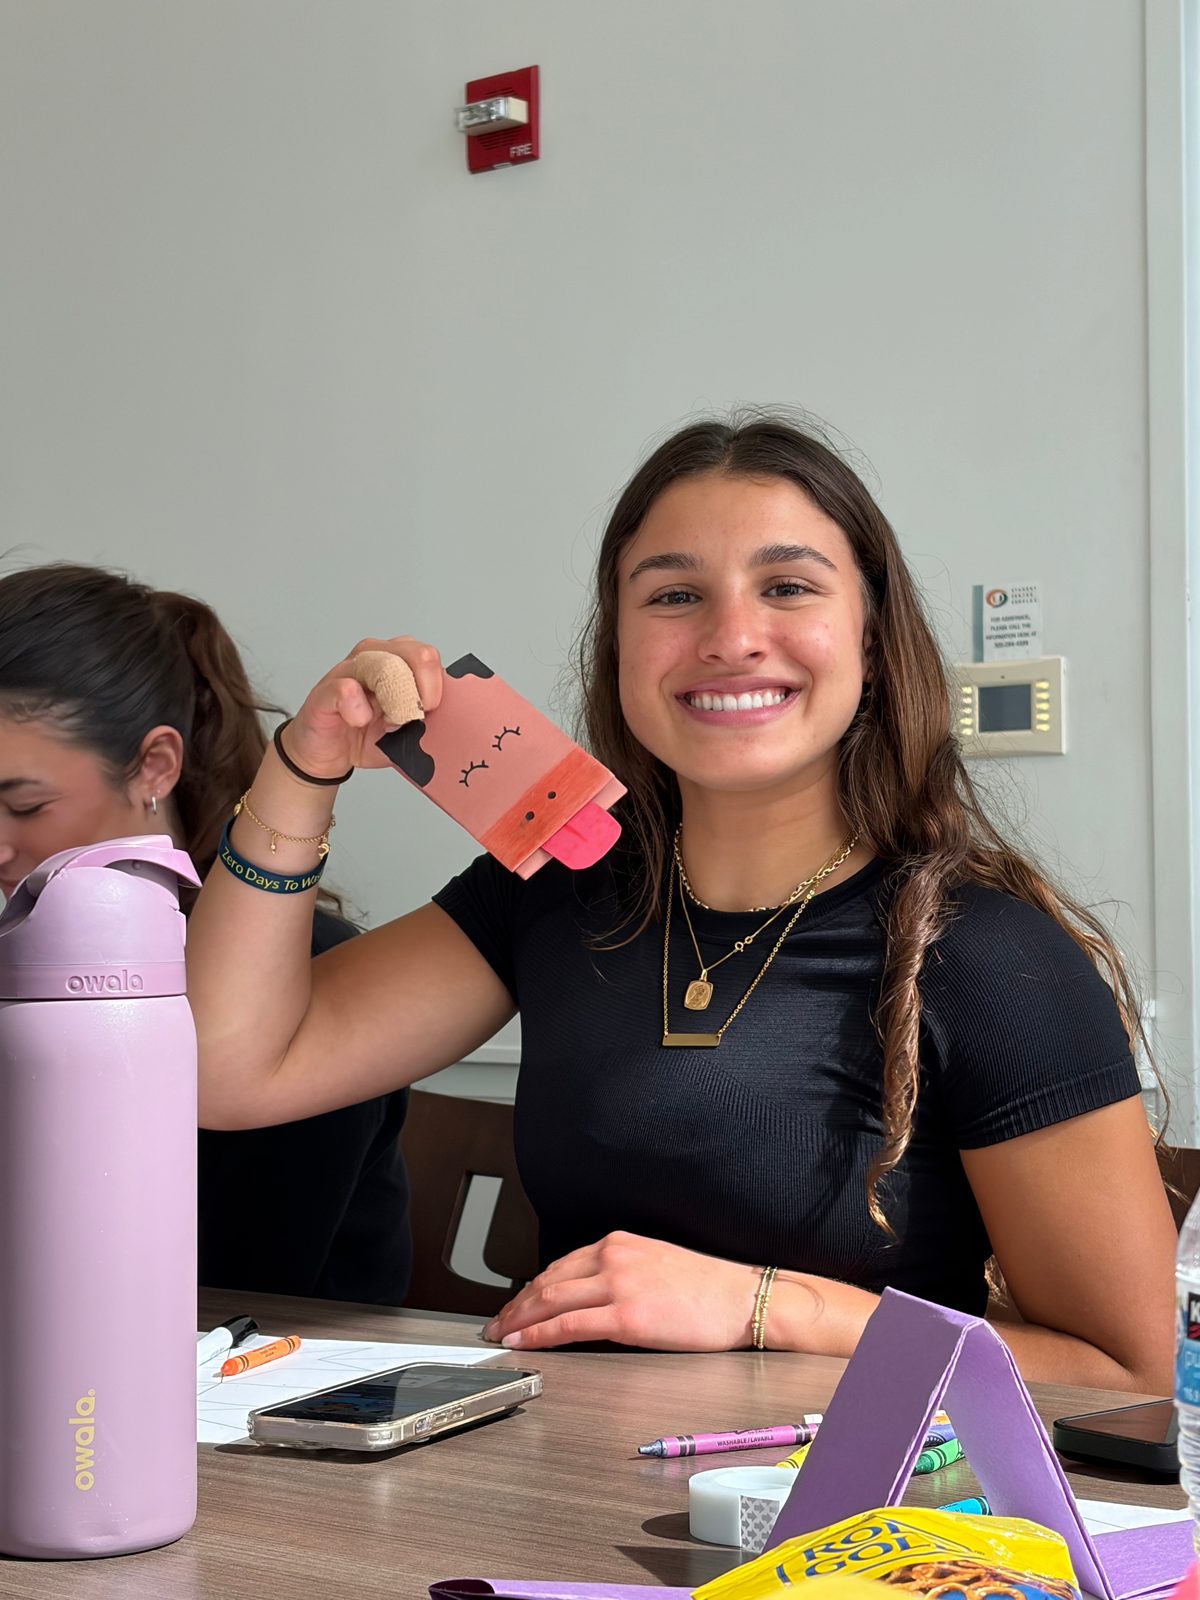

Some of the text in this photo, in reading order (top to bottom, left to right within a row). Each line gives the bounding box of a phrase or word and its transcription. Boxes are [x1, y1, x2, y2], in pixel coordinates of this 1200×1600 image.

[510, 143, 532, 158] FIRE
[221, 846, 244, 874] Zero
[244, 867, 280, 889] Days
[284, 880, 299, 891] To
[65, 968, 144, 994] owala
[716, 1436, 748, 1447] WASHABLE
